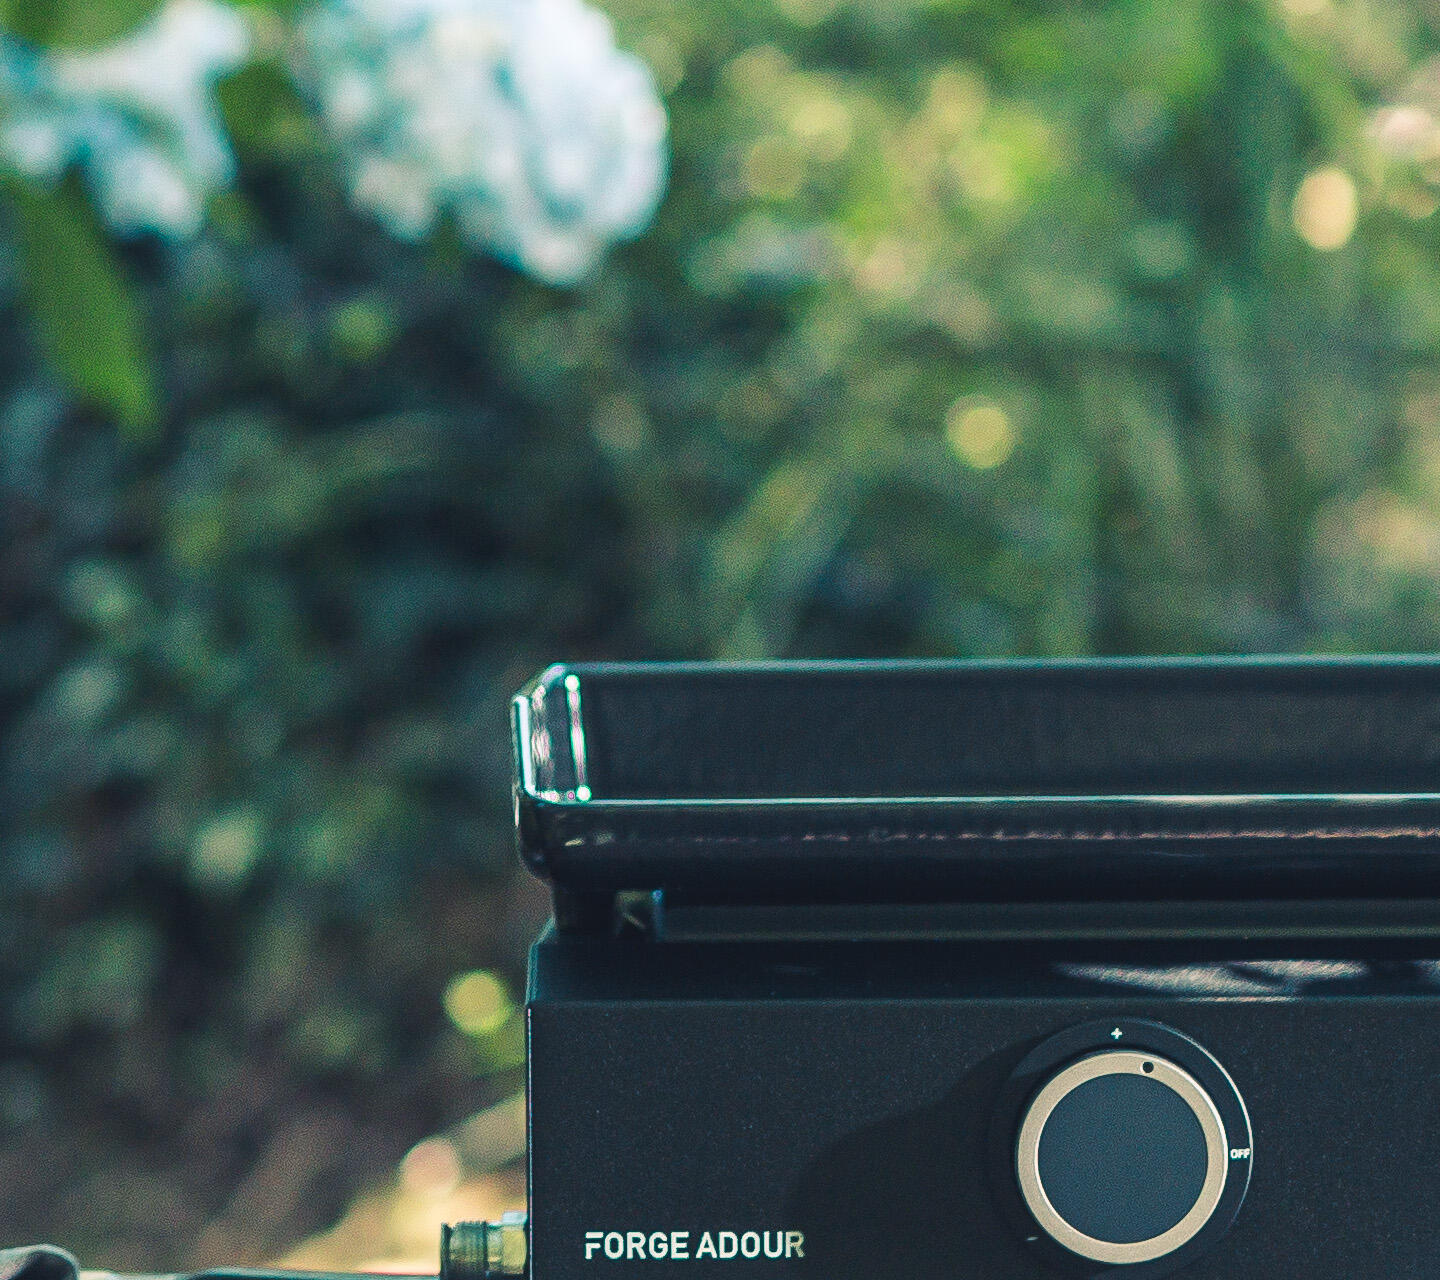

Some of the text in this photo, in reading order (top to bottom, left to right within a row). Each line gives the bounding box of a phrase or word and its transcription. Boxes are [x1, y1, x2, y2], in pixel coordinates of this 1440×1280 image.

[1230, 1148, 1250, 1159] OFF
[585, 1231, 805, 1260] FORGE ADOUR
